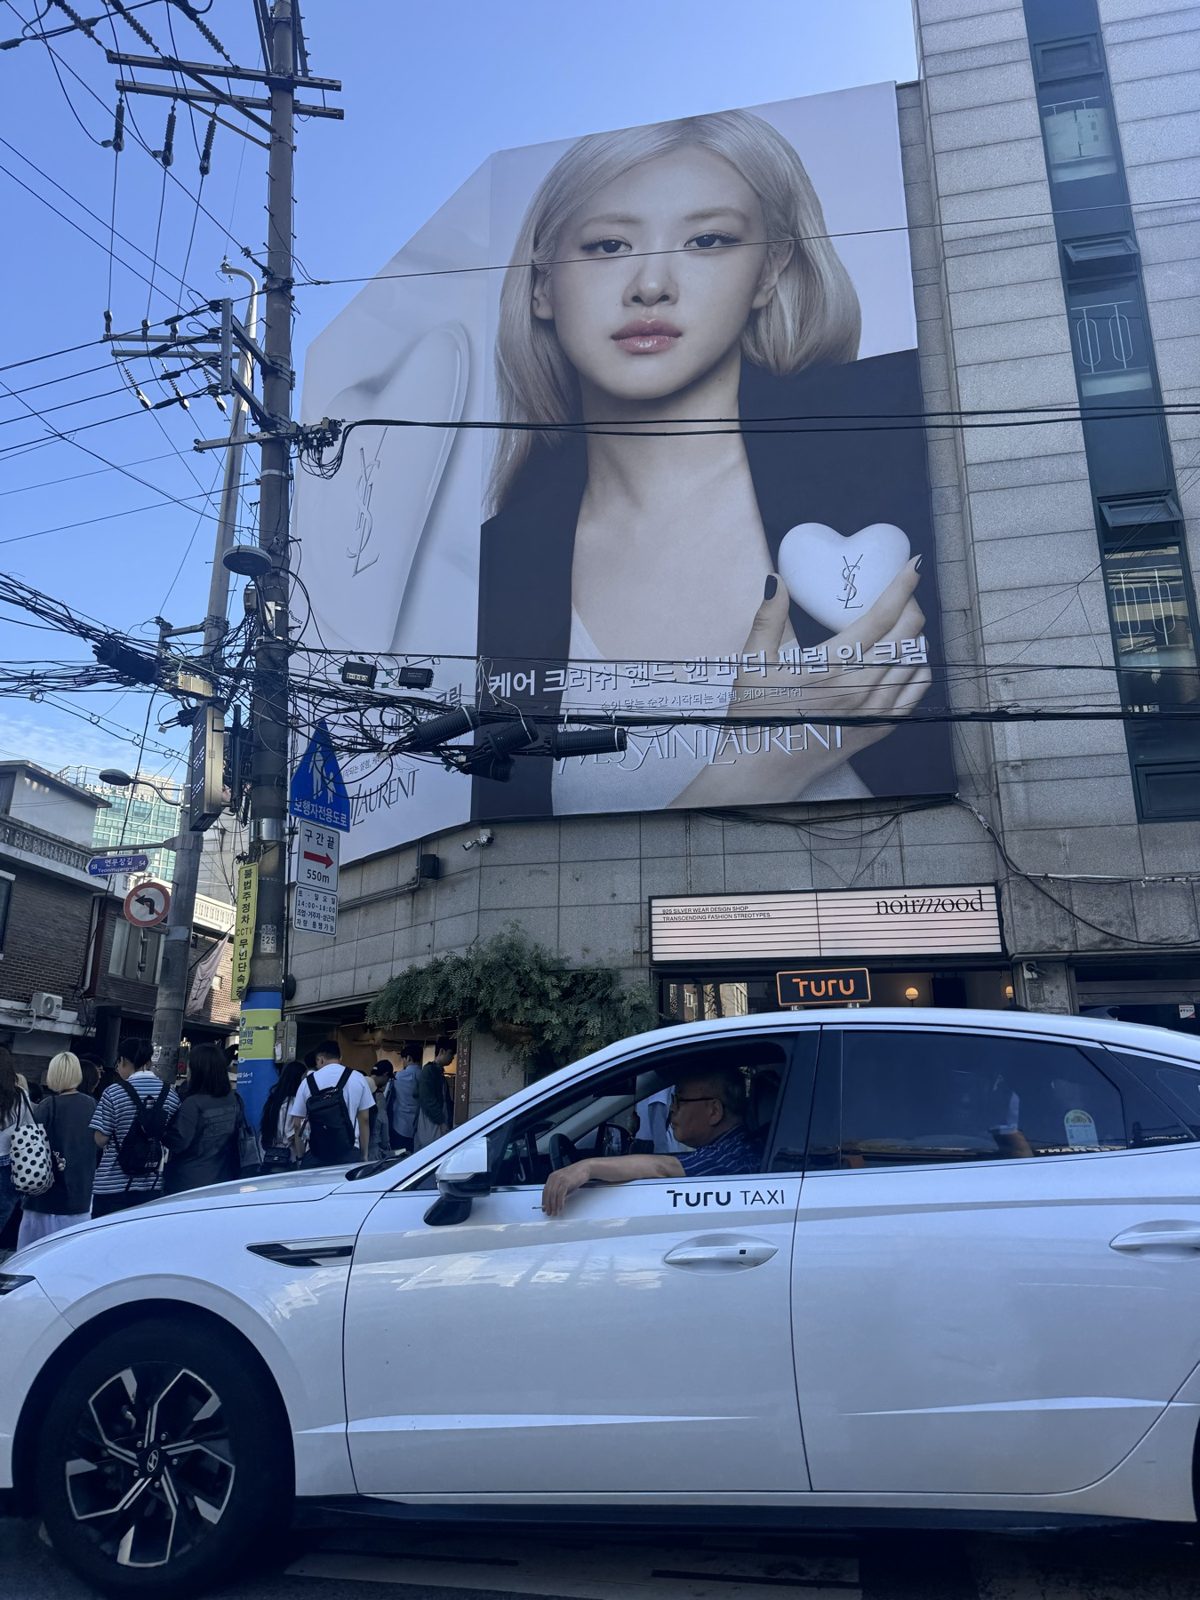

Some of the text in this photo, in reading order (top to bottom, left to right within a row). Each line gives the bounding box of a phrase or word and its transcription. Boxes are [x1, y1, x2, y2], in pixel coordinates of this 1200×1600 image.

[488, 669, 535, 698] 케어
[542, 663, 618, 693] 크러쉬
[776, 646, 830, 675] 세럼
[837, 641, 864, 671] 인
[873, 635, 929, 666] 크림
[352, 769, 420, 827] LAURENT
[293, 797, 348, 827] 보행자전용도로
[105, 857, 133, 867] 연무장길
[306, 868, 330, 884] 550m
[740, 1189, 784, 1205] TAXI
